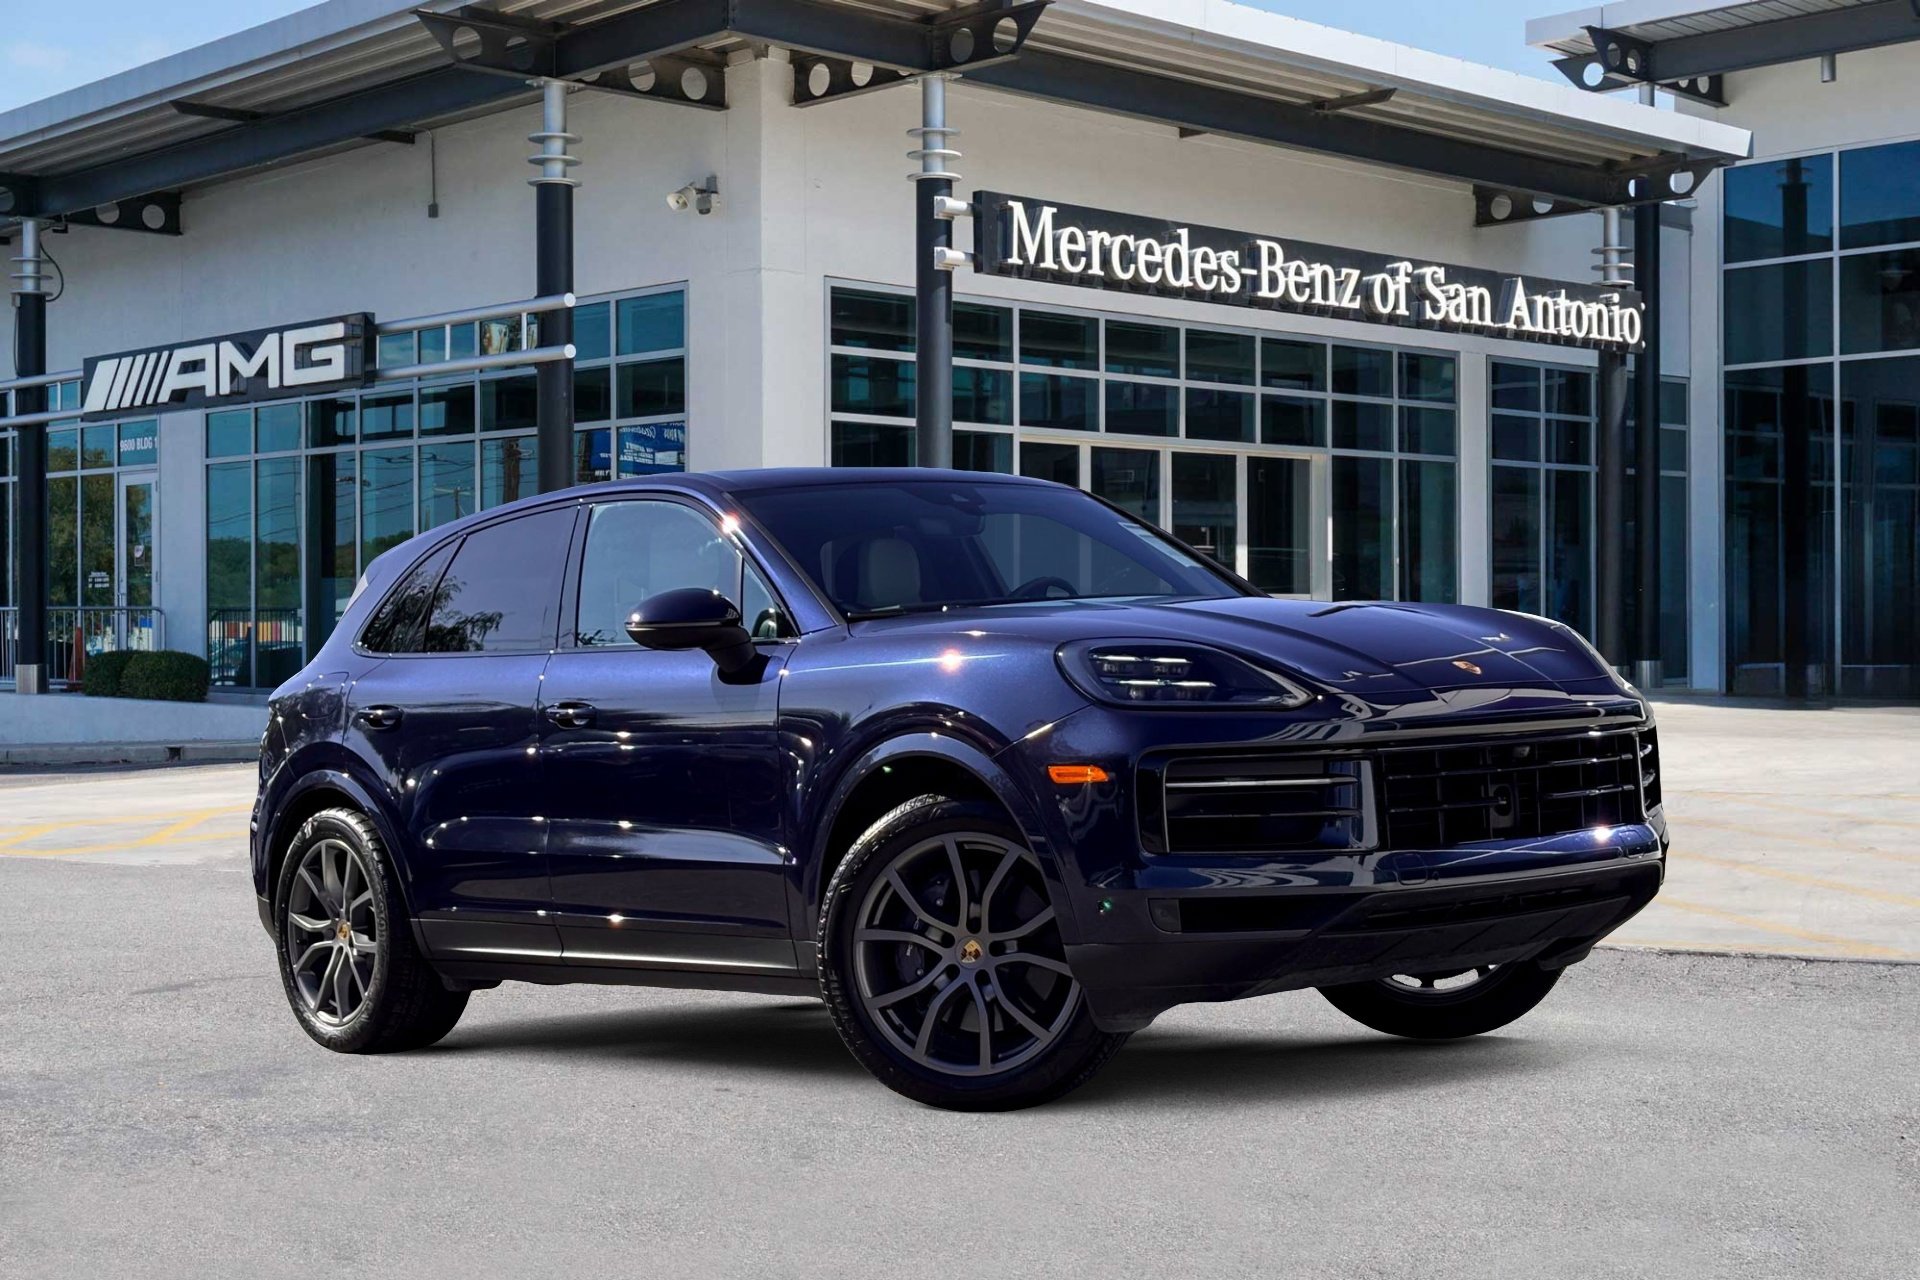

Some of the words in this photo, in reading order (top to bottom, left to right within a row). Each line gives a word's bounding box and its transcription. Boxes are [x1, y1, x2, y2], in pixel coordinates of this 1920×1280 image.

[1007, 200, 1361, 309] Mercedes-Benz
[1373, 261, 1412, 316] of
[1424, 265, 1492, 327] San
[1499, 276, 1641, 344] Antonio
[157, 321, 345, 403] AMG
[136, 437, 152, 450] BLDG
